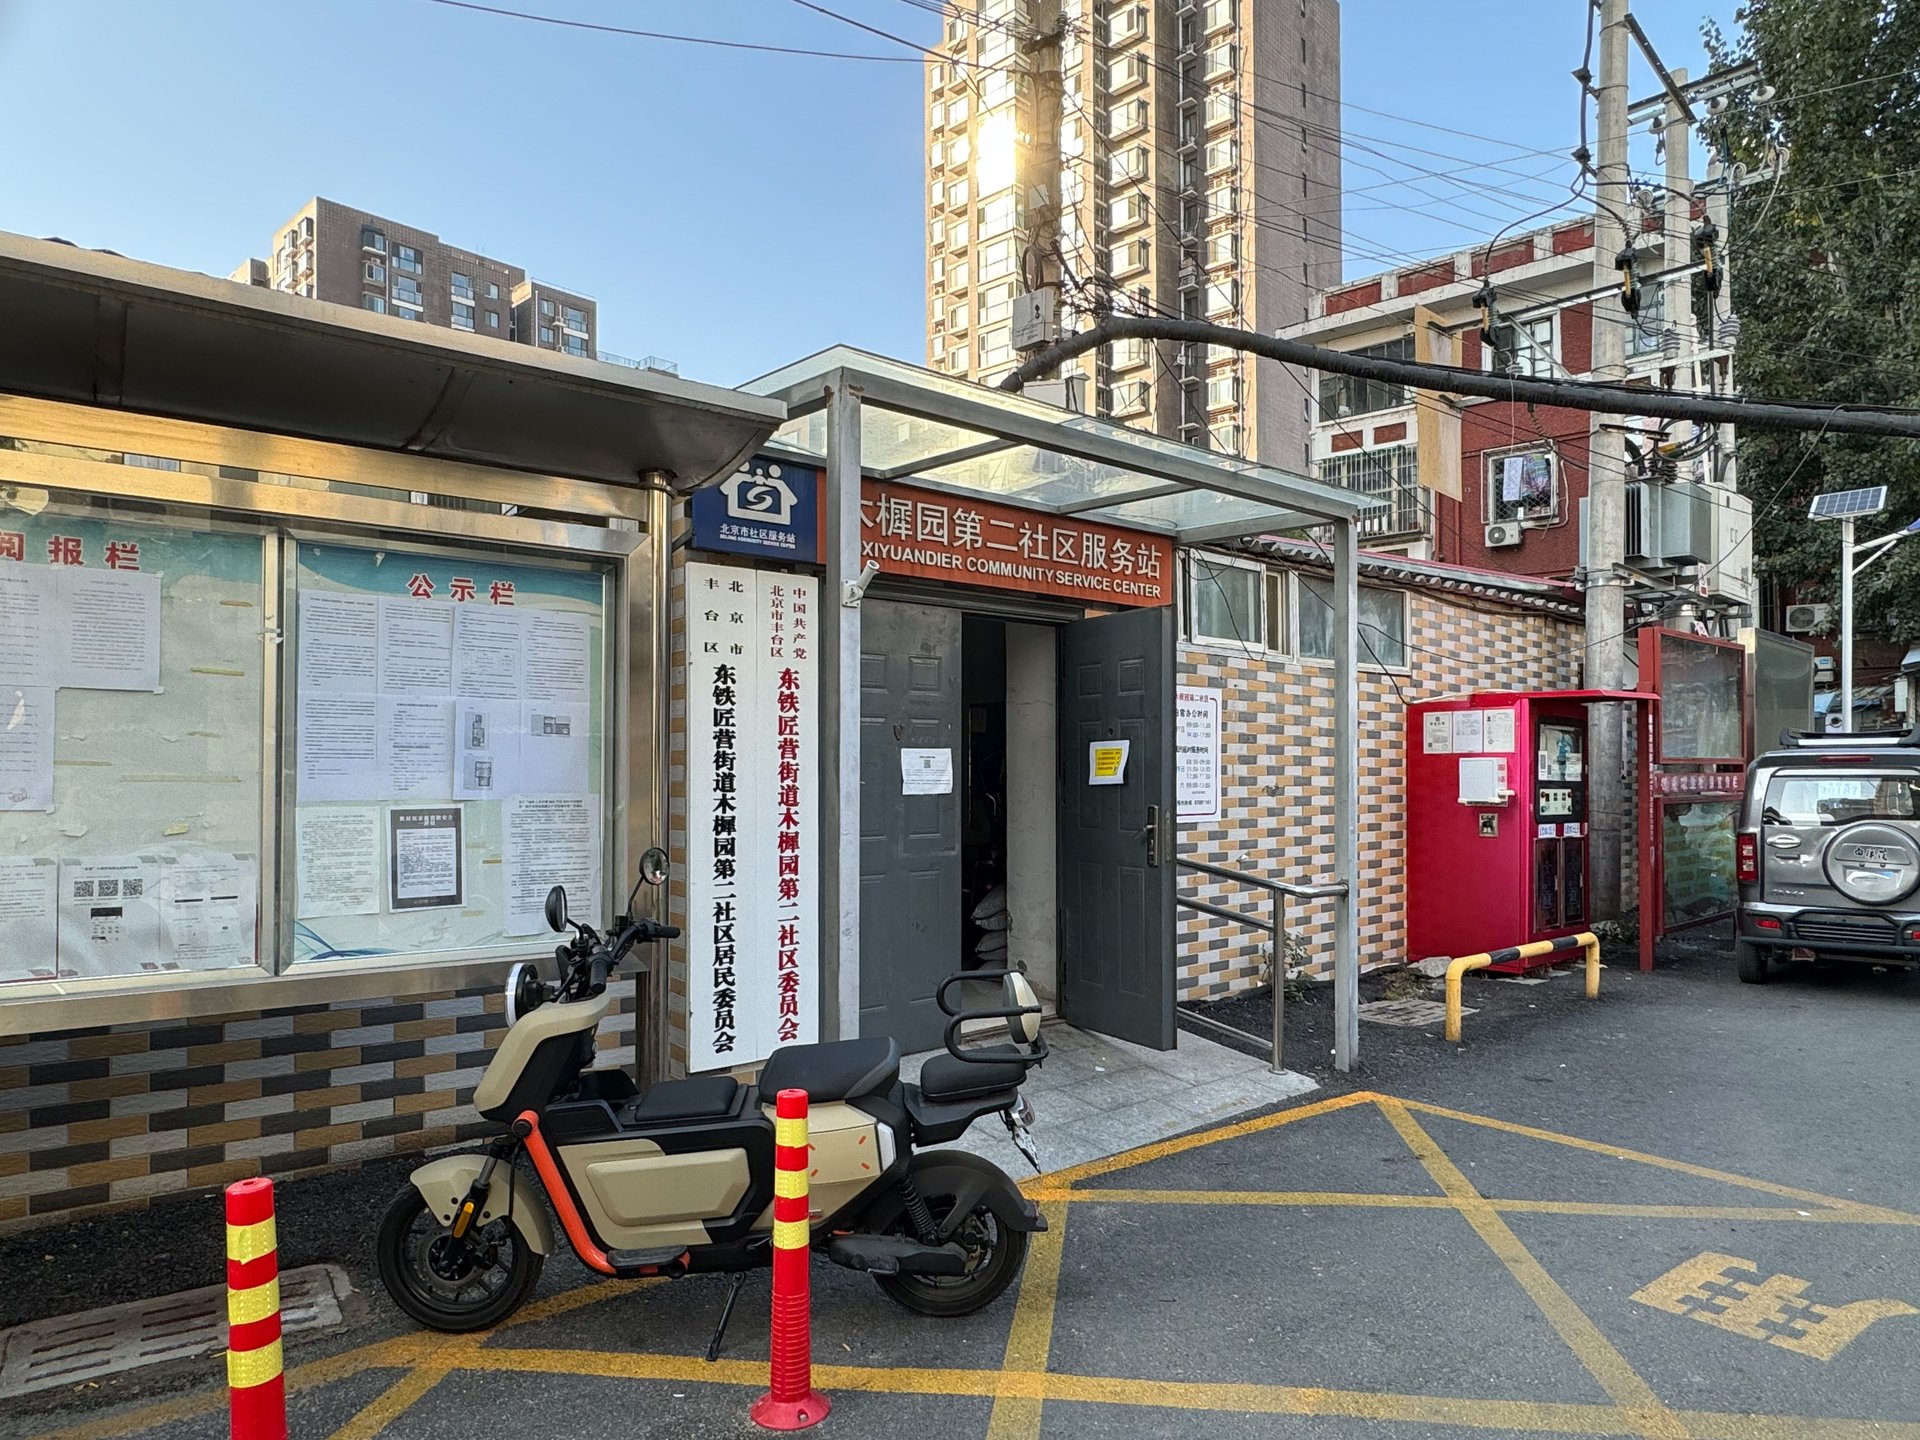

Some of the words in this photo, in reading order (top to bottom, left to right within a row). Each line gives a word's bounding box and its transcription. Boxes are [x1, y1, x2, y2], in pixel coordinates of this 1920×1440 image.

[0, 531, 141, 572] 阅报栏
[720, 523, 796, 544] 北京市社区服务站
[408, 573, 515, 606] 公示栏
[967, 557, 1054, 583] COMMUNITY
[1056, 570, 1111, 592] SERVICE
[1113, 579, 1161, 599] CENTER
[704, 578, 720, 653] 丰台区
[728, 580, 744, 656] 北京市
[770, 585, 784, 658] 北京市丰台区
[793, 587, 807, 660] 中国共产党
[713, 663, 737, 1055] 东铁匠营街道木樨园第二社区居民委员会
[777, 667, 800, 1042] 东铁匠营街道木樨园第二社区委员会
